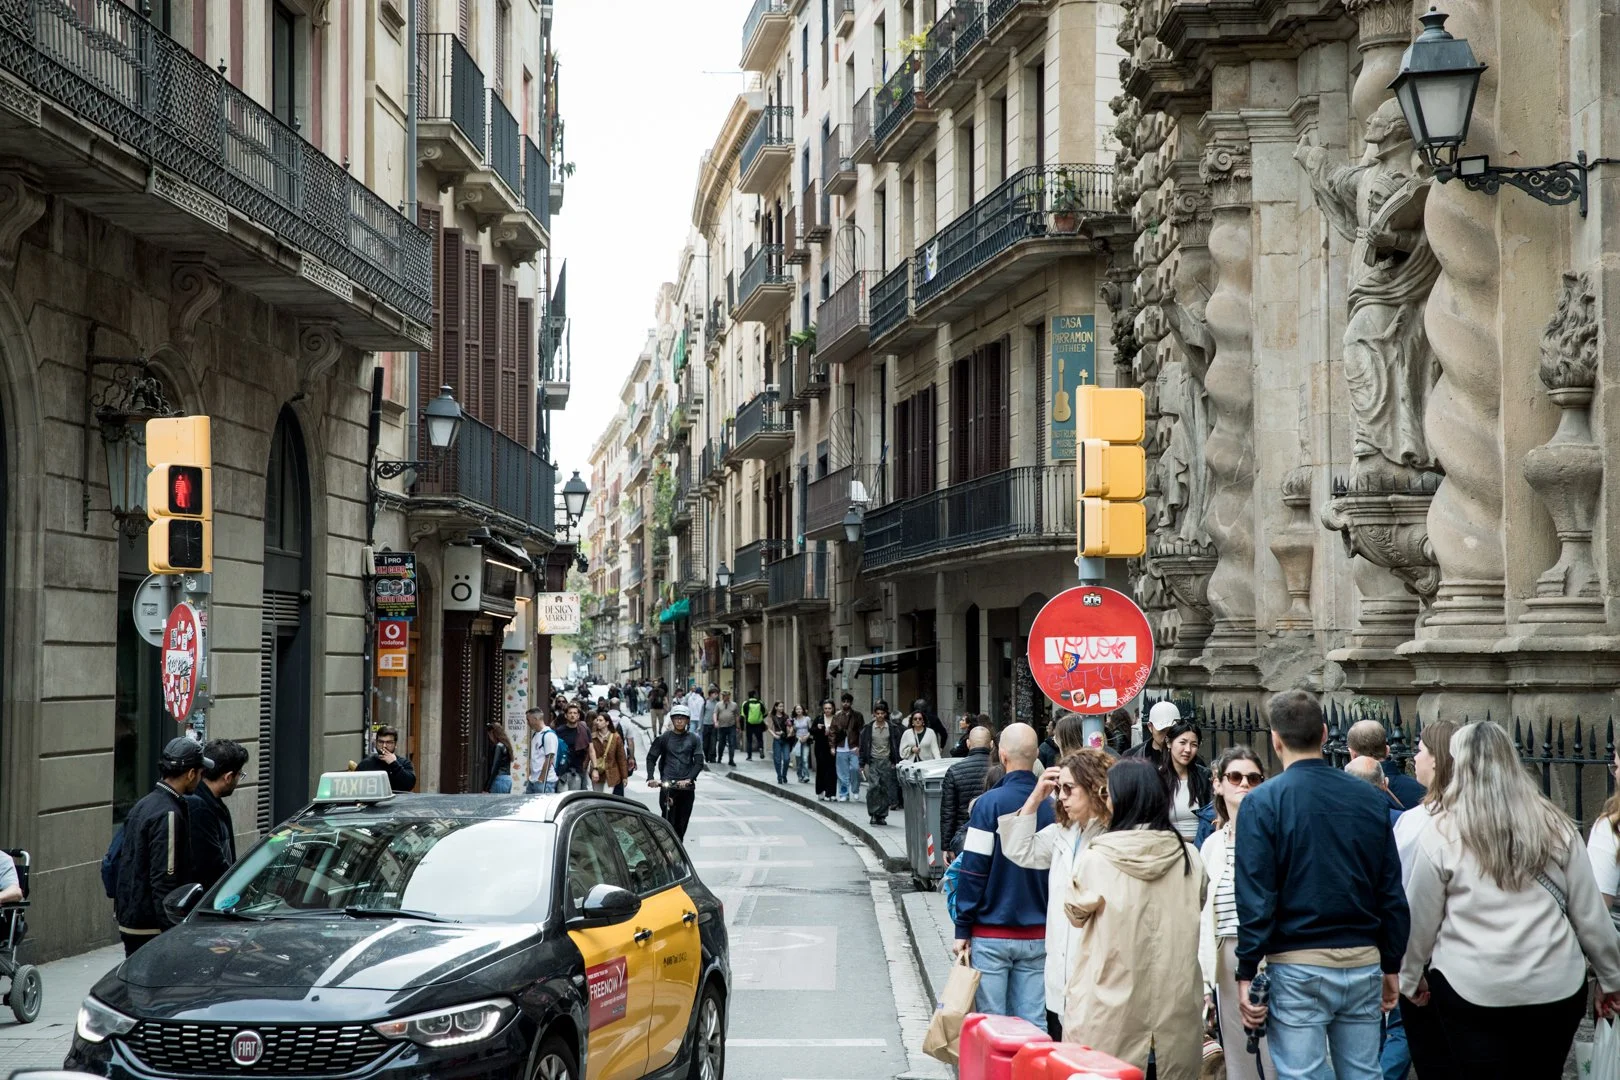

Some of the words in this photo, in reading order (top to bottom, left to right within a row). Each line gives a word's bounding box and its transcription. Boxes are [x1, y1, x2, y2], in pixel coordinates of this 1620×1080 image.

[1060, 316, 1082, 329] CASA
[1052, 331, 1094, 344] PARRAMON
[1056, 343, 1087, 353] LUTHIER
[545, 604, 573, 614] DESIGN
[333, 777, 364, 796] TAXI
[238, 1041, 257, 1057] FIAT
